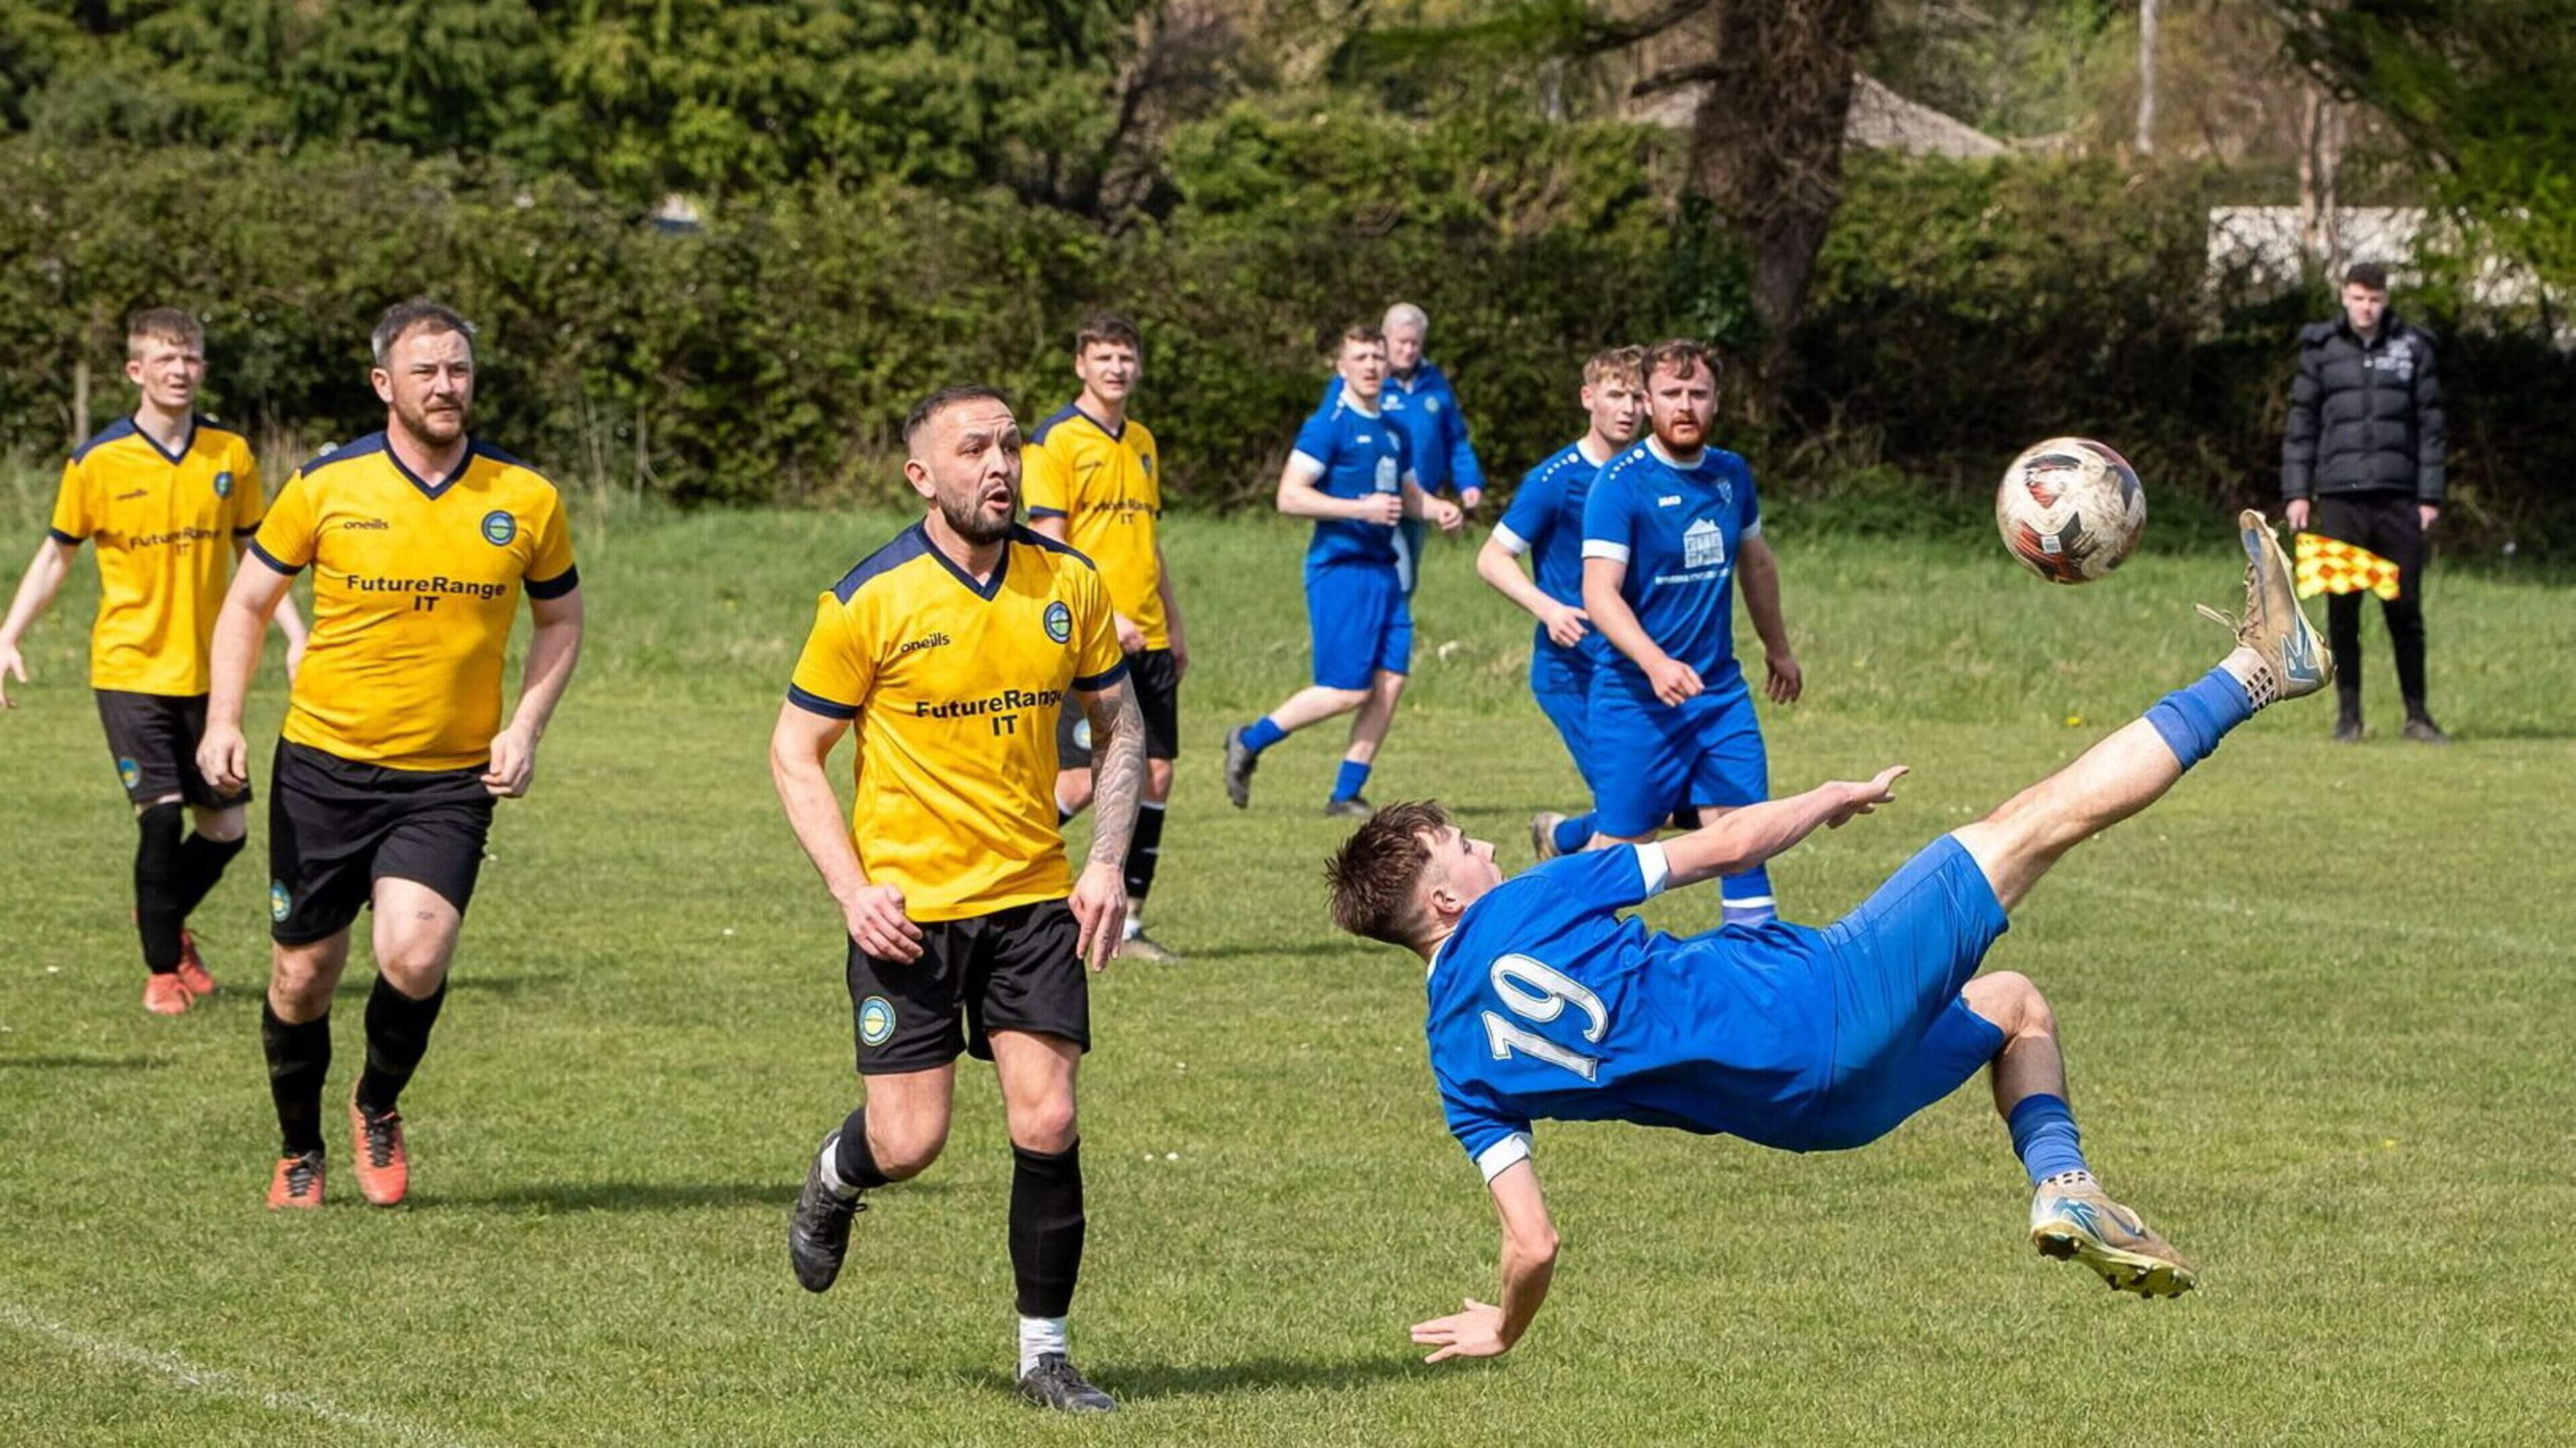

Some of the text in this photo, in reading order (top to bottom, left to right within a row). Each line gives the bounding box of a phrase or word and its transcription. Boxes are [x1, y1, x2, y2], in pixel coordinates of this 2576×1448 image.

[344, 518, 389, 530] oneills
[347, 575, 506, 600] FutureRange
[413, 596, 439, 611] IT
[901, 632, 951, 654] oneills
[991, 714, 1018, 736] IT
[1482, 952, 1608, 1082] 19
